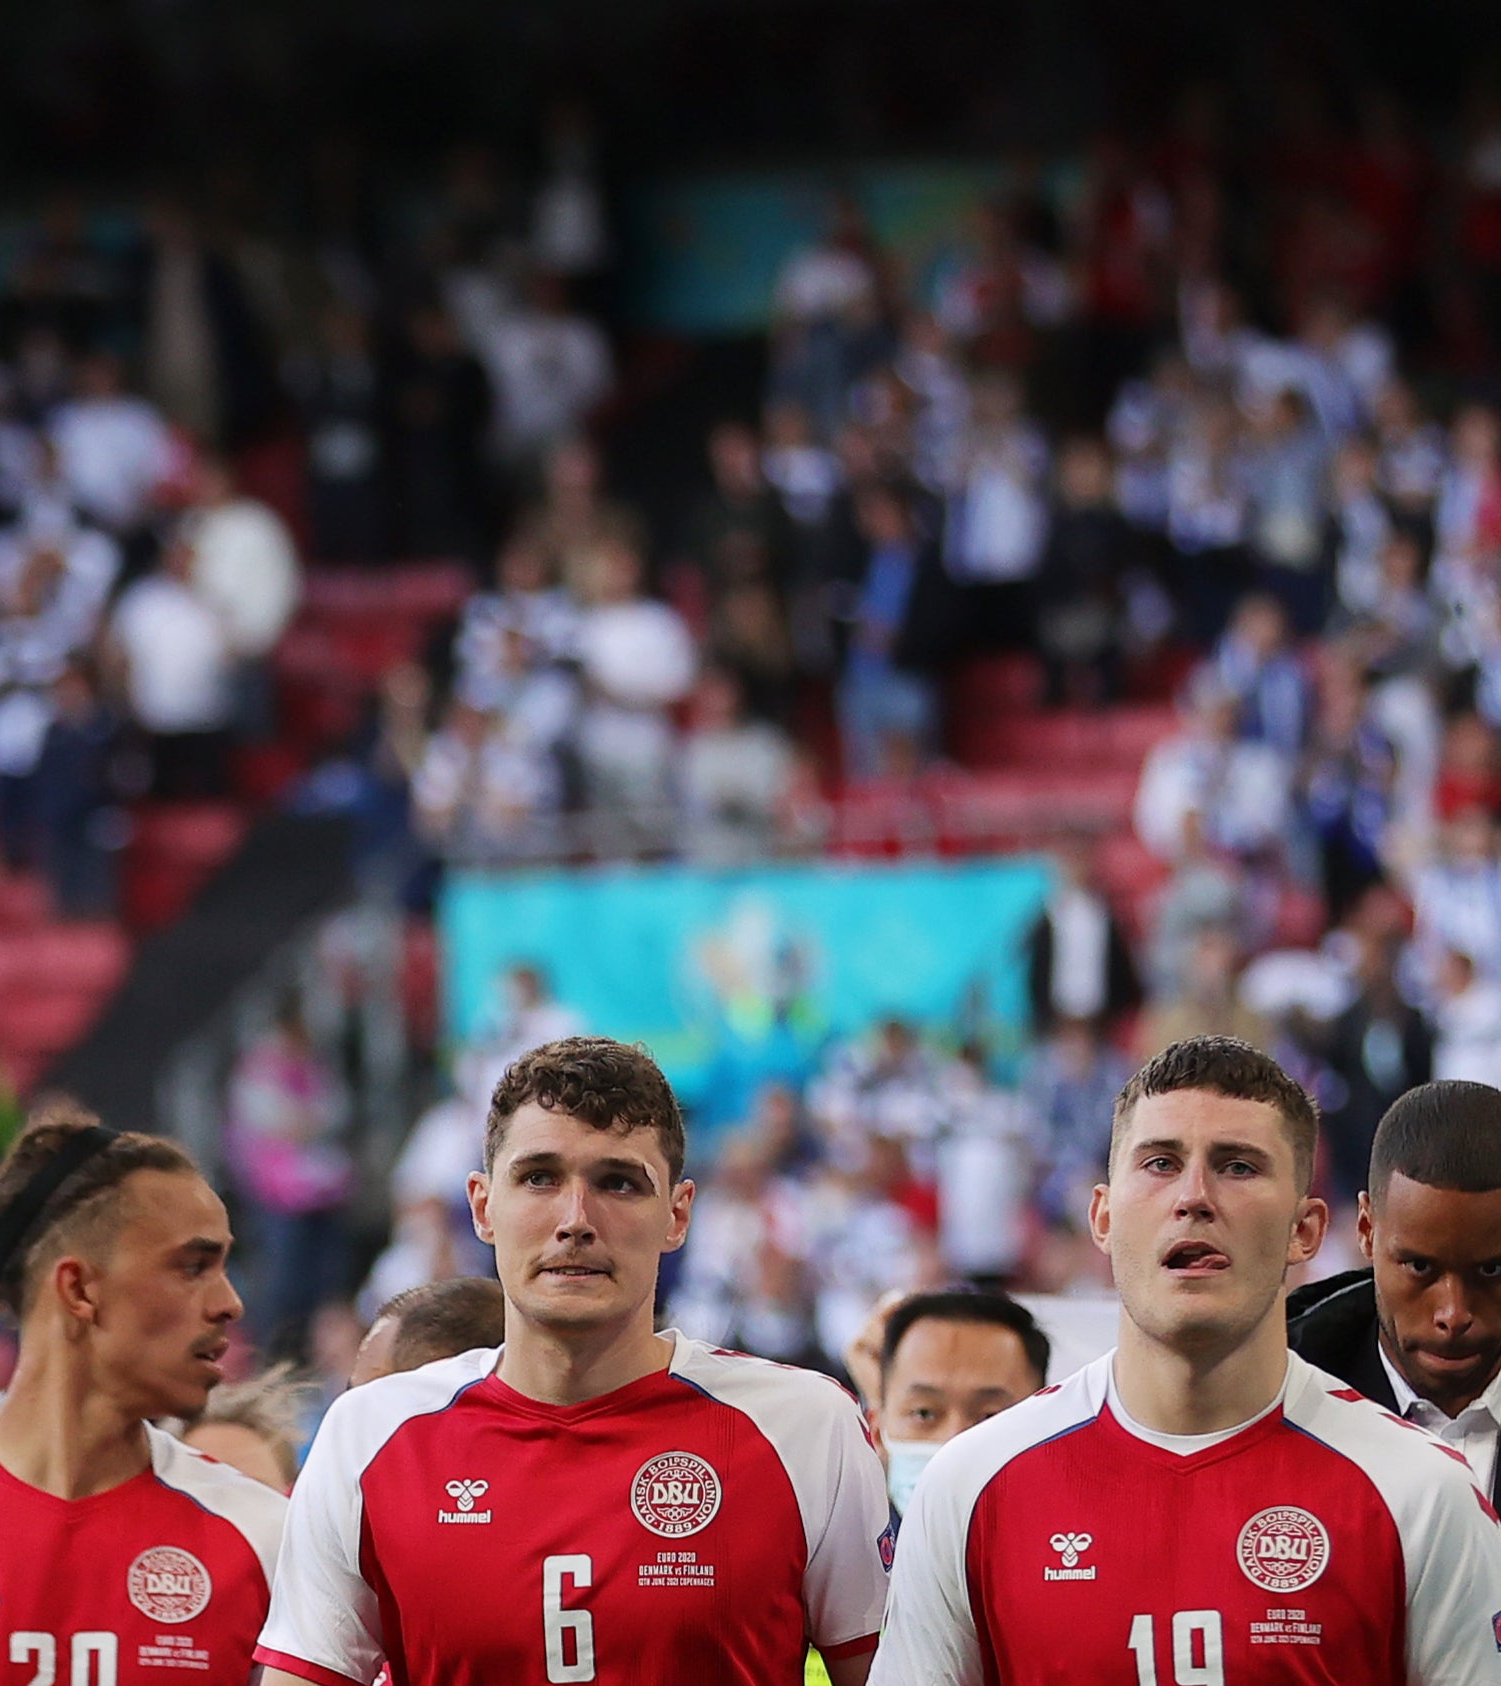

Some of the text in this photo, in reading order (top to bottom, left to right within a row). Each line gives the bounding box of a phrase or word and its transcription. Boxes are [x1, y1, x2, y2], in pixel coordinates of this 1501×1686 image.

[636, 1477, 655, 1524] DANSK
[695, 1480, 716, 1523] UNION
[651, 1481, 700, 1505] DBU
[438, 1509, 491, 1524] hummel
[658, 1521, 692, 1534] 1889
[1257, 1535, 1309, 1560] DBU
[657, 1552, 696, 1563] EURO 2020
[1303, 1536, 1325, 1579] UNION
[639, 1565, 673, 1576] DENMARK
[683, 1565, 714, 1576] FINLAND
[1044, 1565, 1096, 1581] hummel
[1264, 1577, 1299, 1588] 1889
[543, 1554, 596, 1684] 6
